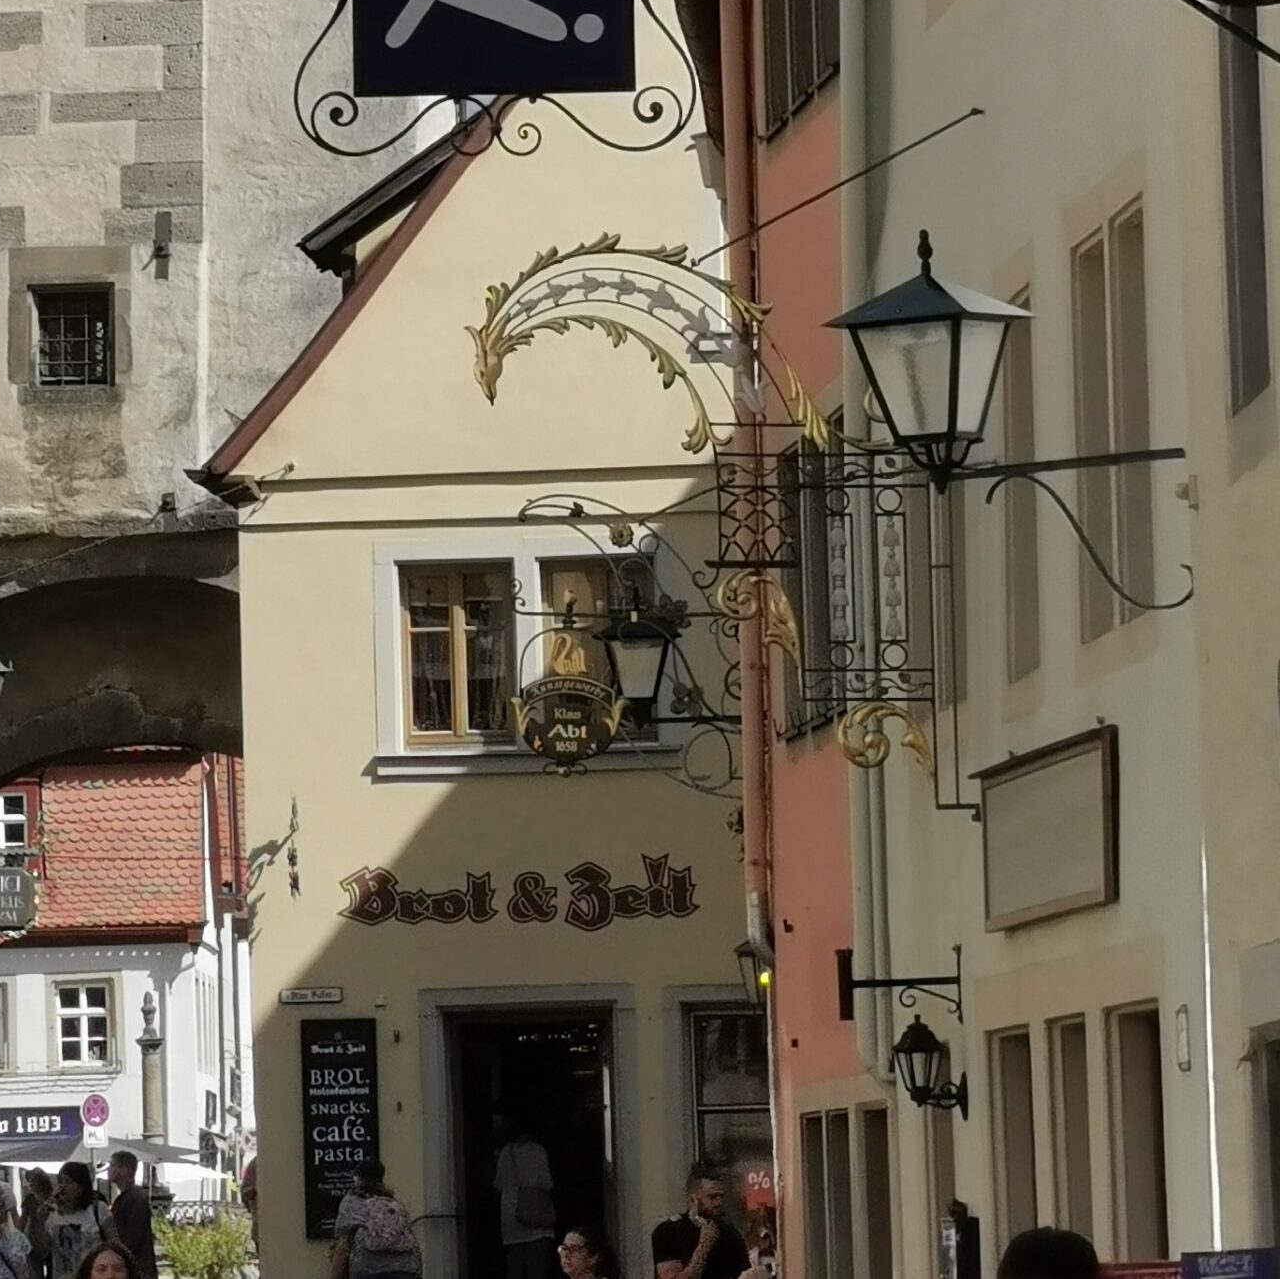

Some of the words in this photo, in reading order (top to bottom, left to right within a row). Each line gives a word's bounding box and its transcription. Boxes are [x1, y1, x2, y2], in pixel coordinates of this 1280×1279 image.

[531, 680, 607, 699] Kunstgewerbe
[554, 706, 582, 719] Klaus
[547, 723, 588, 738] Abt
[555, 740, 578, 753] 1658
[337, 865, 501, 926] Brot
[507, 871, 558, 924] &
[564, 853, 702, 932] Zeit
[15, 1115, 62, 1134] 1893
[312, 1115, 372, 1143] café.
